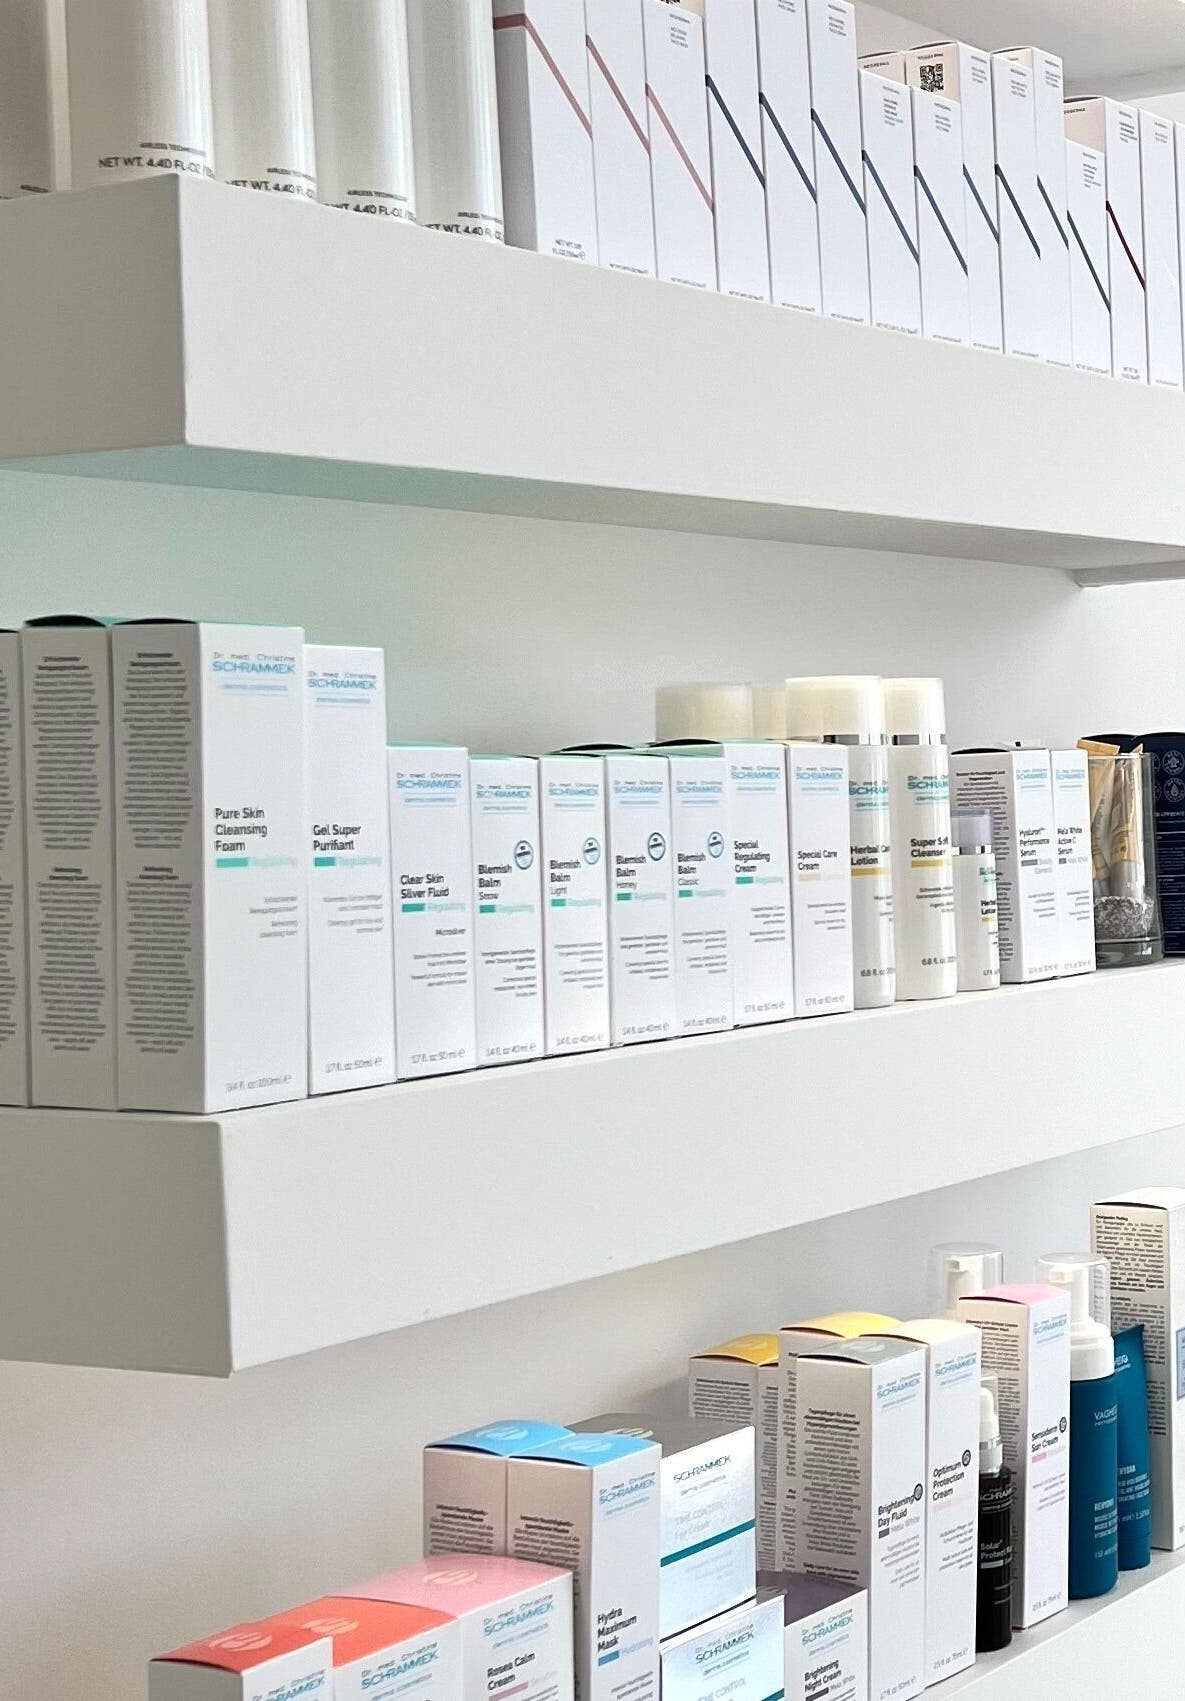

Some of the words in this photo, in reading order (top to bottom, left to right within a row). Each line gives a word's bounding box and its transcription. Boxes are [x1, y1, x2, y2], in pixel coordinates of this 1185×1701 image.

[99, 157, 119, 169] NET
[147, 158, 172, 169] 4.40
[212, 661, 296, 675] SCHRAMMEK
[307, 678, 377, 690] SCHRAMMEK
[215, 807, 240, 820] Pure
[242, 807, 265, 819] Skin
[215, 823, 268, 838] Cleansing
[313, 824, 331, 836] Gel
[332, 824, 362, 837] Super
[215, 840, 246, 852] Foam
[313, 839, 355, 852] Purifiant
[734, 840, 759, 851] Special
[911, 838, 937, 848] Super
[797, 850, 822, 862] Special
[850, 845, 879, 855] Herbal
[616, 855, 647, 866] Blemish
[677, 852, 707, 863] Blemish
[734, 852, 771, 864] Regulating
[851, 857, 879, 867] Lotion
[478, 864, 513, 875] Blemish
[550, 859, 582, 871] Blemish
[677, 865, 697, 876] Balm
[734, 864, 757, 874] Cream
[798, 862, 820, 871] Cream
[426, 873, 445, 885] Skin
[550, 872, 571, 883] Balm
[616, 867, 636, 878] Balm
[478, 877, 502, 889] Balm
[400, 888, 426, 900] Silver
[428, 886, 450, 898] Fluid
[673, 1455, 731, 1484] SCHRAMMEK
[933, 1461, 962, 1478] Optimum
[932, 1471, 965, 1490] Protection
[599, 1477, 656, 1505] SCHRAMMEK
[932, 1488, 954, 1502] Cream
[877, 1494, 915, 1517] Brightening
[877, 1516, 891, 1529] Day
[891, 1507, 908, 1523] Fluid
[483, 1600, 554, 1638] SCHRAMMEK
[597, 1607, 623, 1625] Hydra
[597, 1614, 637, 1639] Maximum
[802, 1615, 855, 1647] SCHRAMMEK
[597, 1635, 620, 1653] Mask
[695, 1630, 755, 1665] SCHRAMMEK
[361, 1649, 439, 1691] SCHRAMMEK
[804, 1659, 840, 1682] Brightening
[487, 1673, 516, 1691] Cream
[804, 1678, 822, 1693] Night
[822, 1669, 842, 1684] Cream
